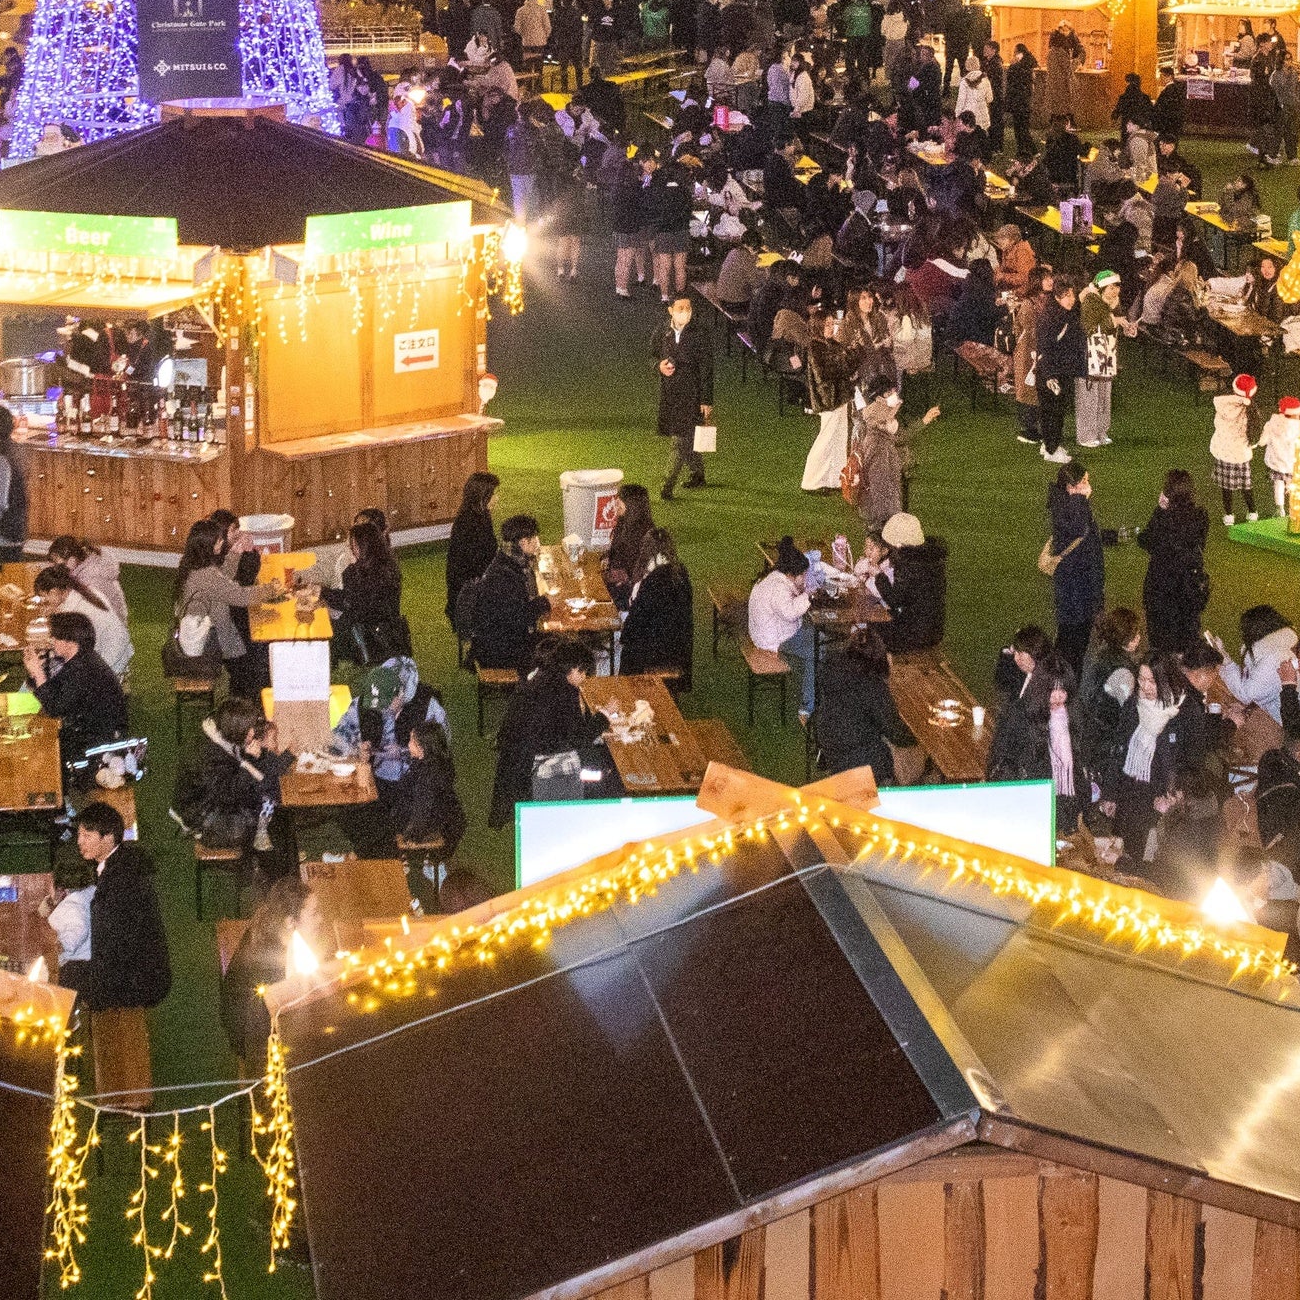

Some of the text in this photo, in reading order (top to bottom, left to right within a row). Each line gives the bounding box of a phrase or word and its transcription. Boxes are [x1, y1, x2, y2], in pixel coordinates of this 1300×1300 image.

[151, 19, 227, 29] Christmas Gate Park
[64, 226, 112, 247] Beer
[370, 220, 413, 241] Wine
[398, 336, 436, 351] ご注文口
